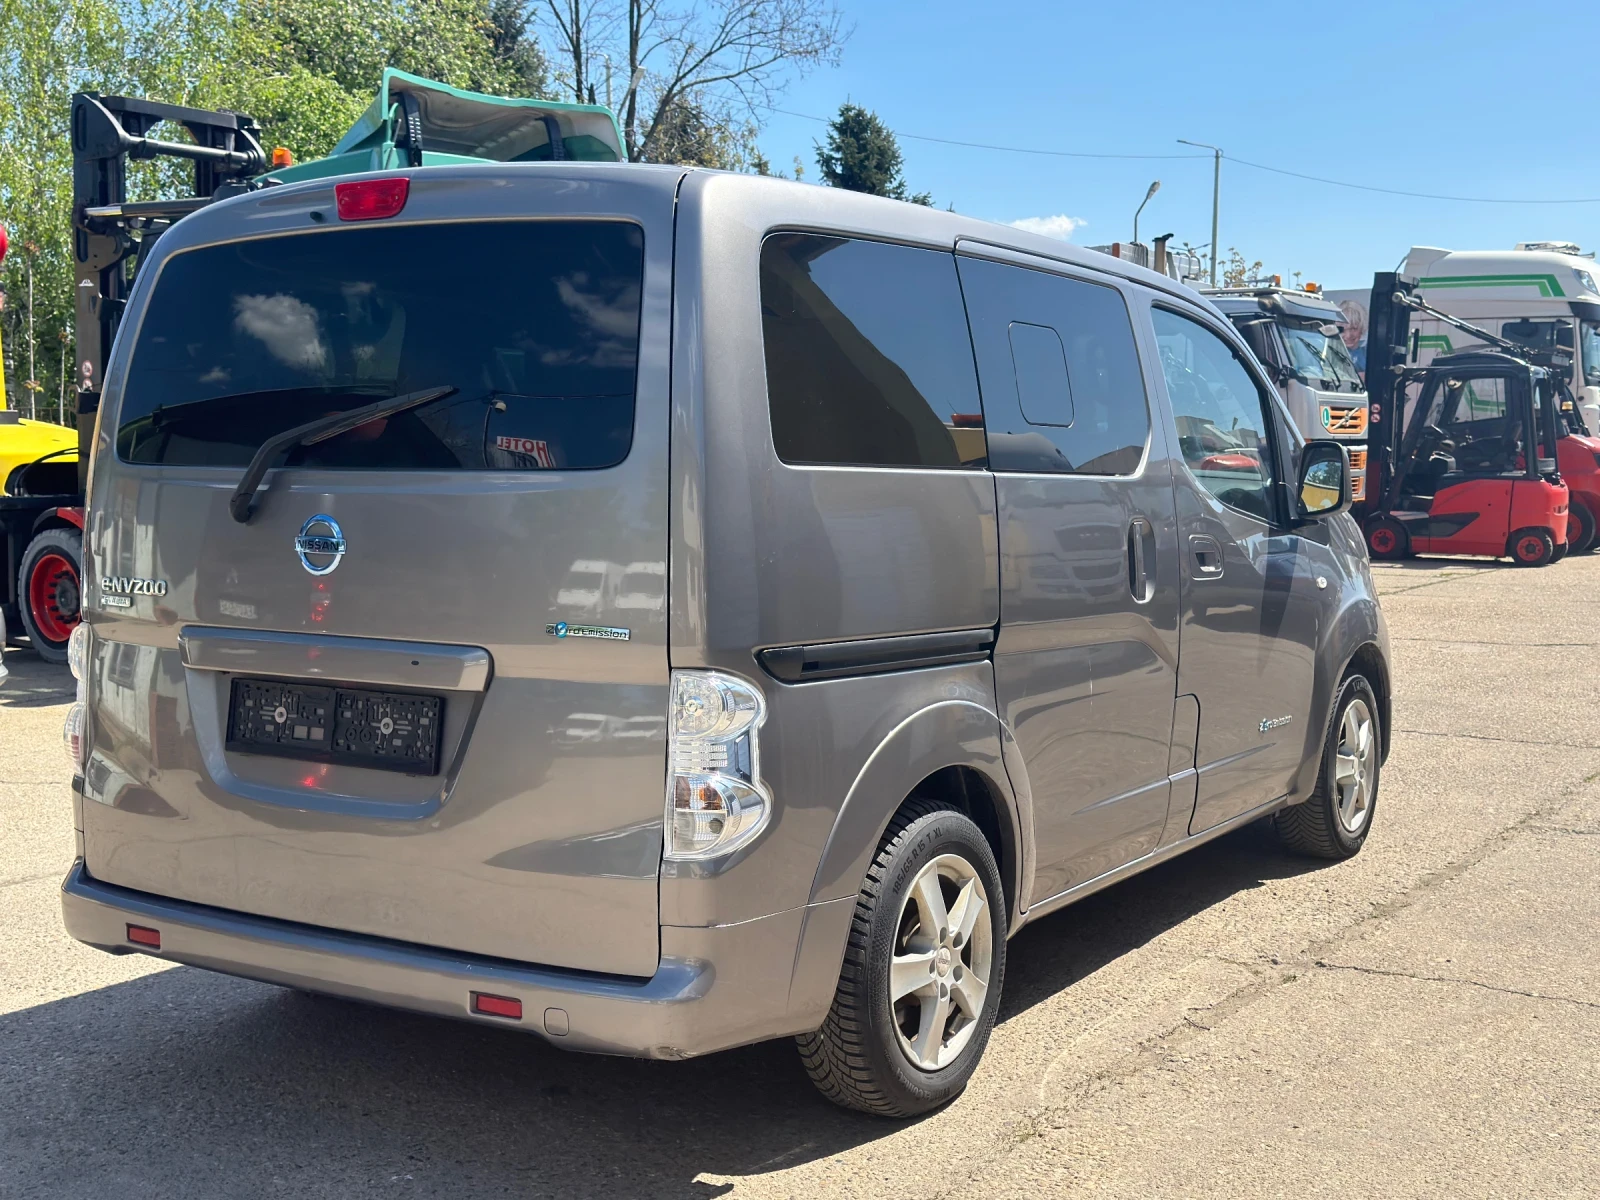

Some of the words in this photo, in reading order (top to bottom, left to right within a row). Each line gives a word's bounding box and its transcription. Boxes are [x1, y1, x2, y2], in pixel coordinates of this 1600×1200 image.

[298, 540, 339, 551] NISSAN
[892, 856, 913, 896] 185/65
[926, 832, 933, 843] T
[933, 827, 943, 838] XL
